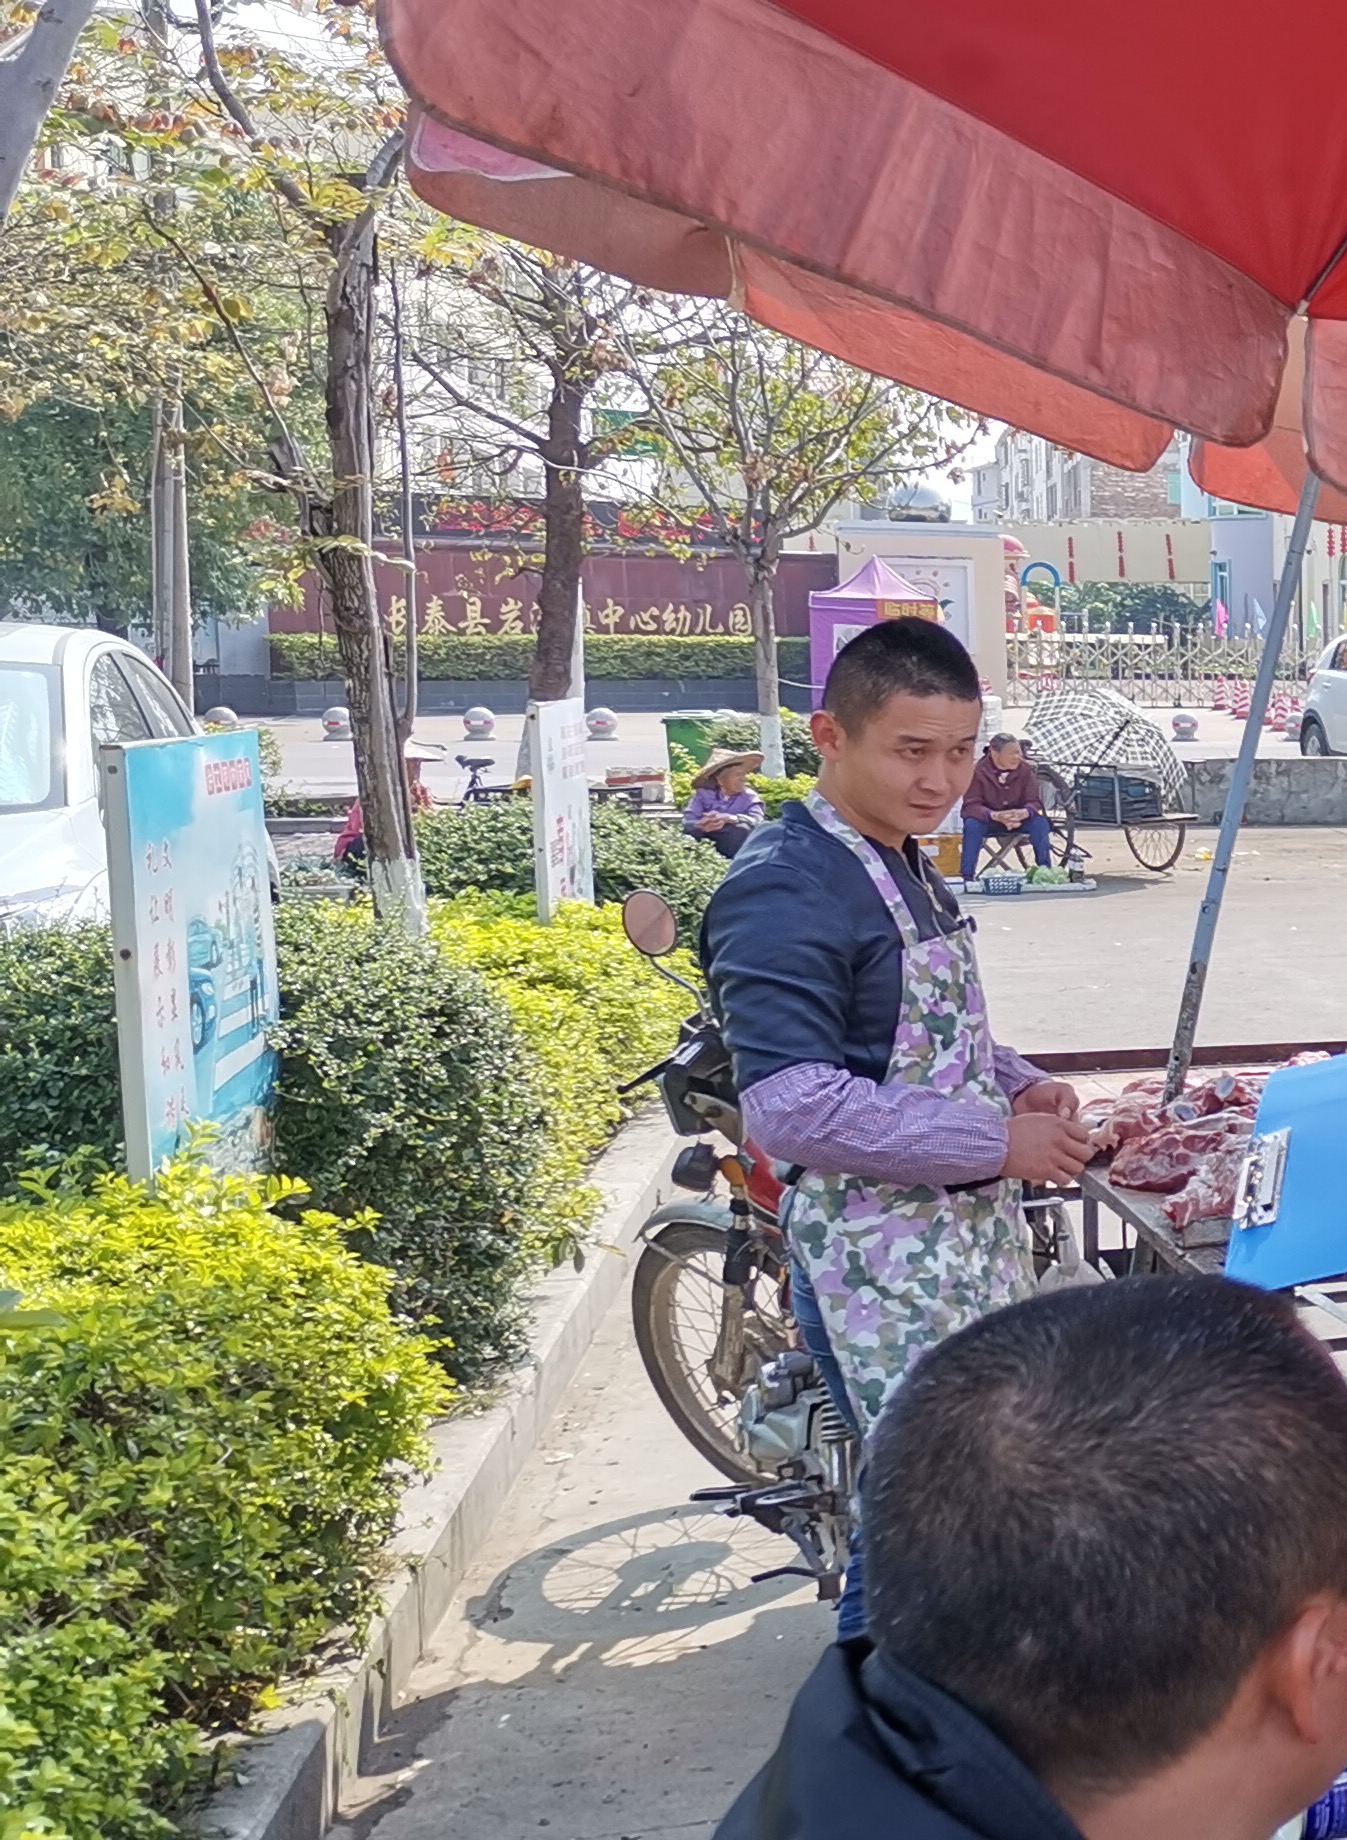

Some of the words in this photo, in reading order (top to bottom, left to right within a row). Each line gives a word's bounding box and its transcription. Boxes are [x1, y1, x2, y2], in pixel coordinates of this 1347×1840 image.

[383, 596, 754, 636] 长泰县岩中心幼儿园
